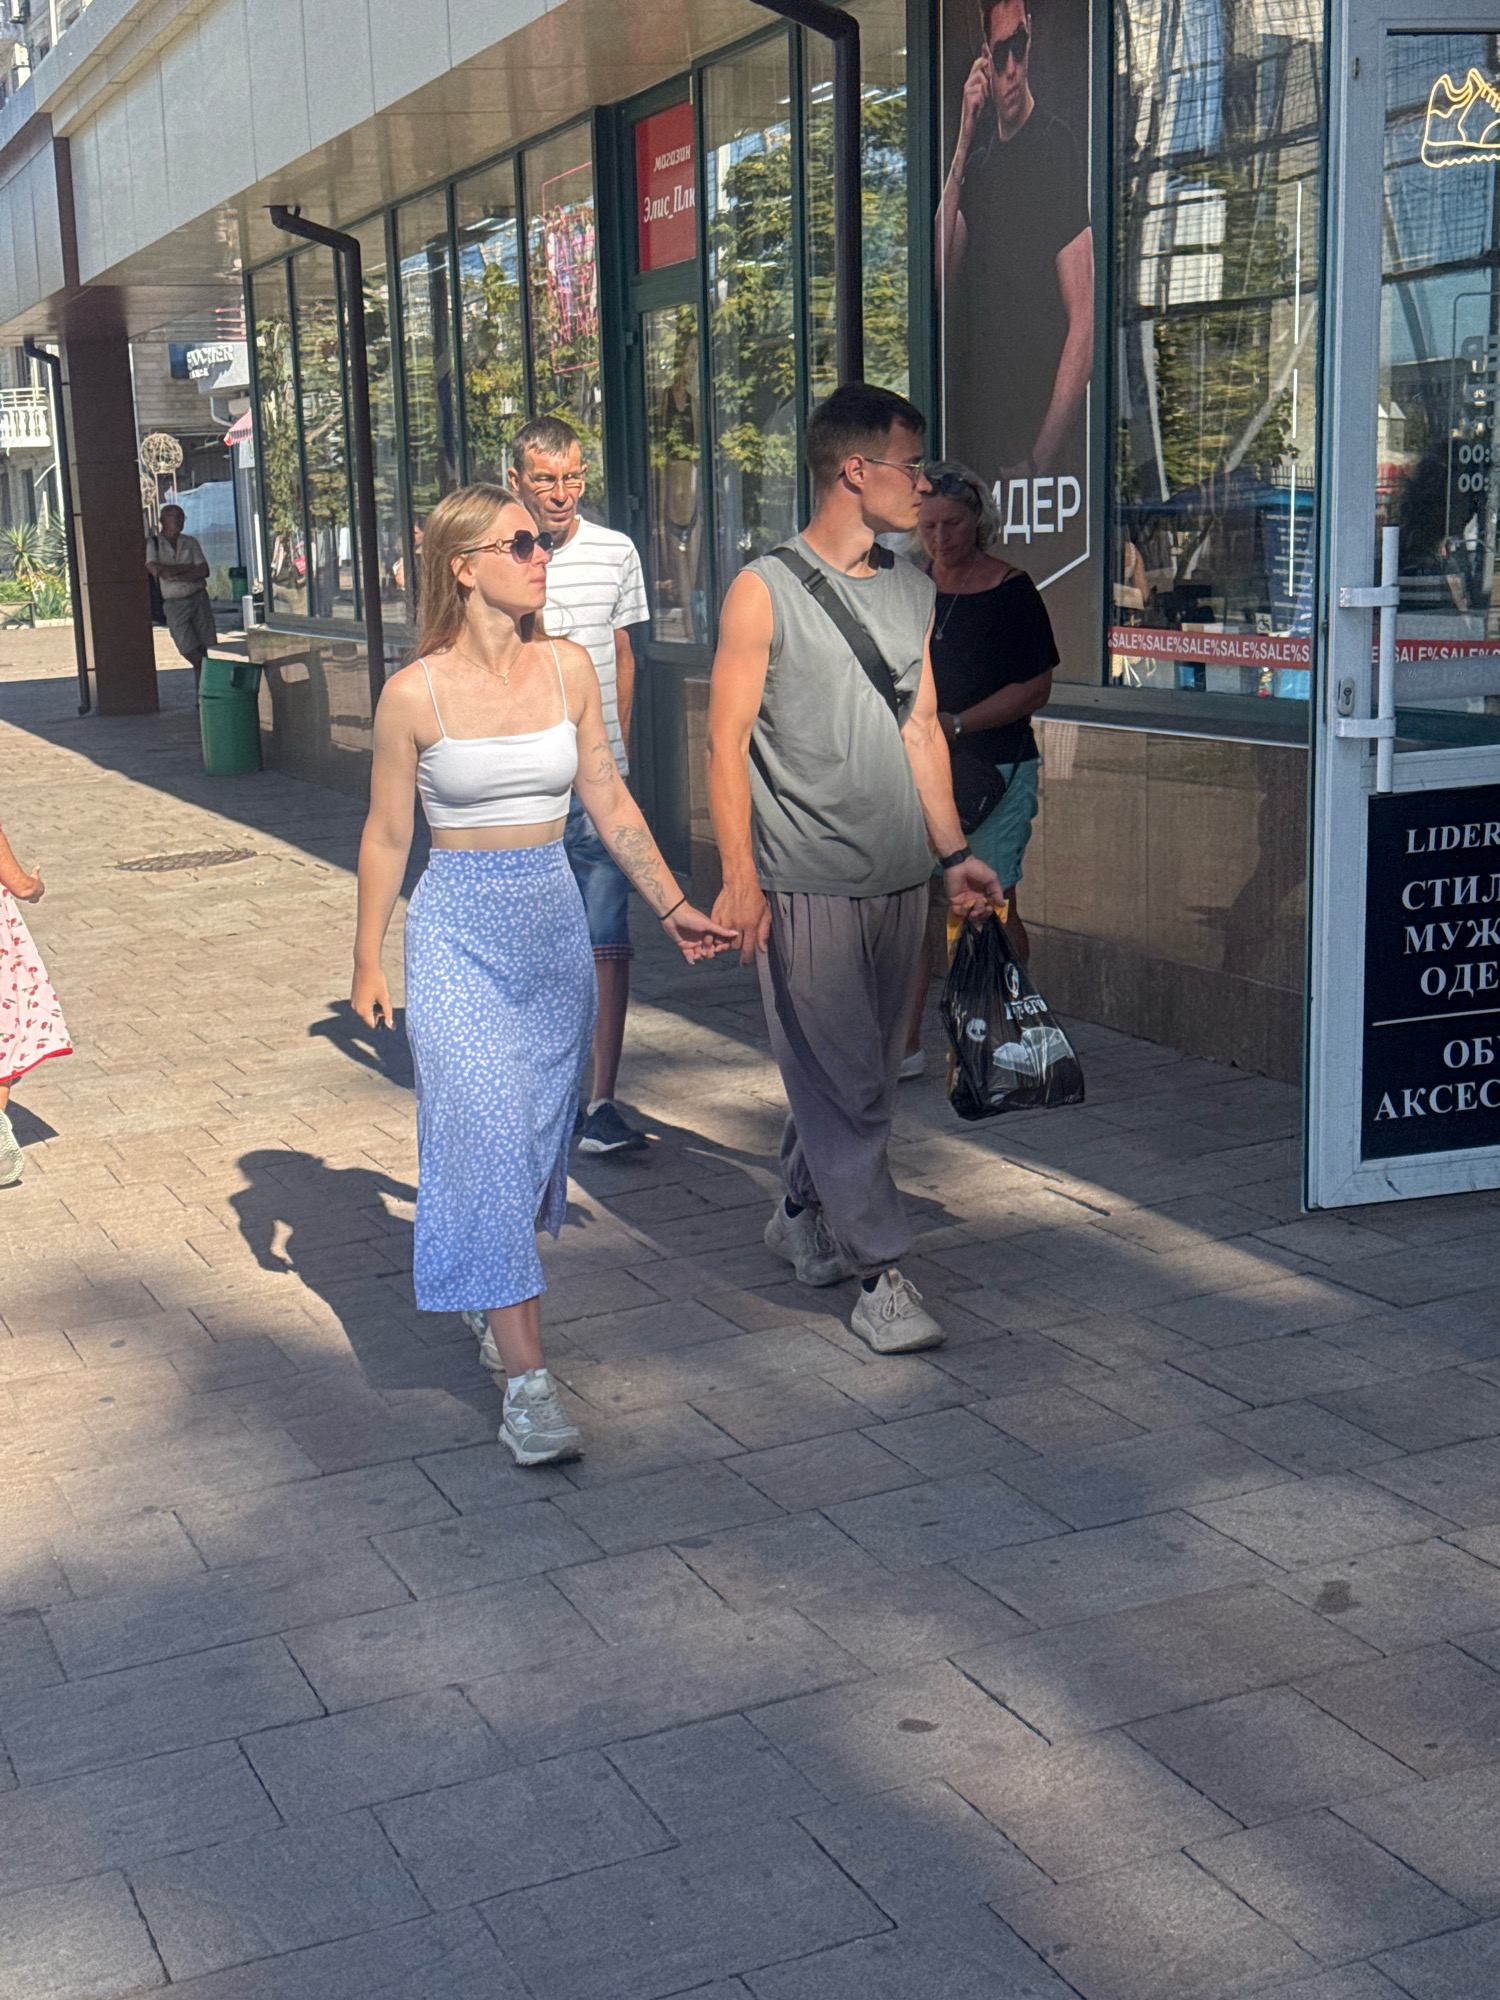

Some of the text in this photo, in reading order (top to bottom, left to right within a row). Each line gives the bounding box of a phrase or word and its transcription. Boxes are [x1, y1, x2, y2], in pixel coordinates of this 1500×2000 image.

[653, 144, 691, 172] магазин
[1405, 821, 1500, 854] LIDER
[1420, 961, 1499, 1000] ОДЕ
[1443, 1035, 1500, 1069] ОБ
